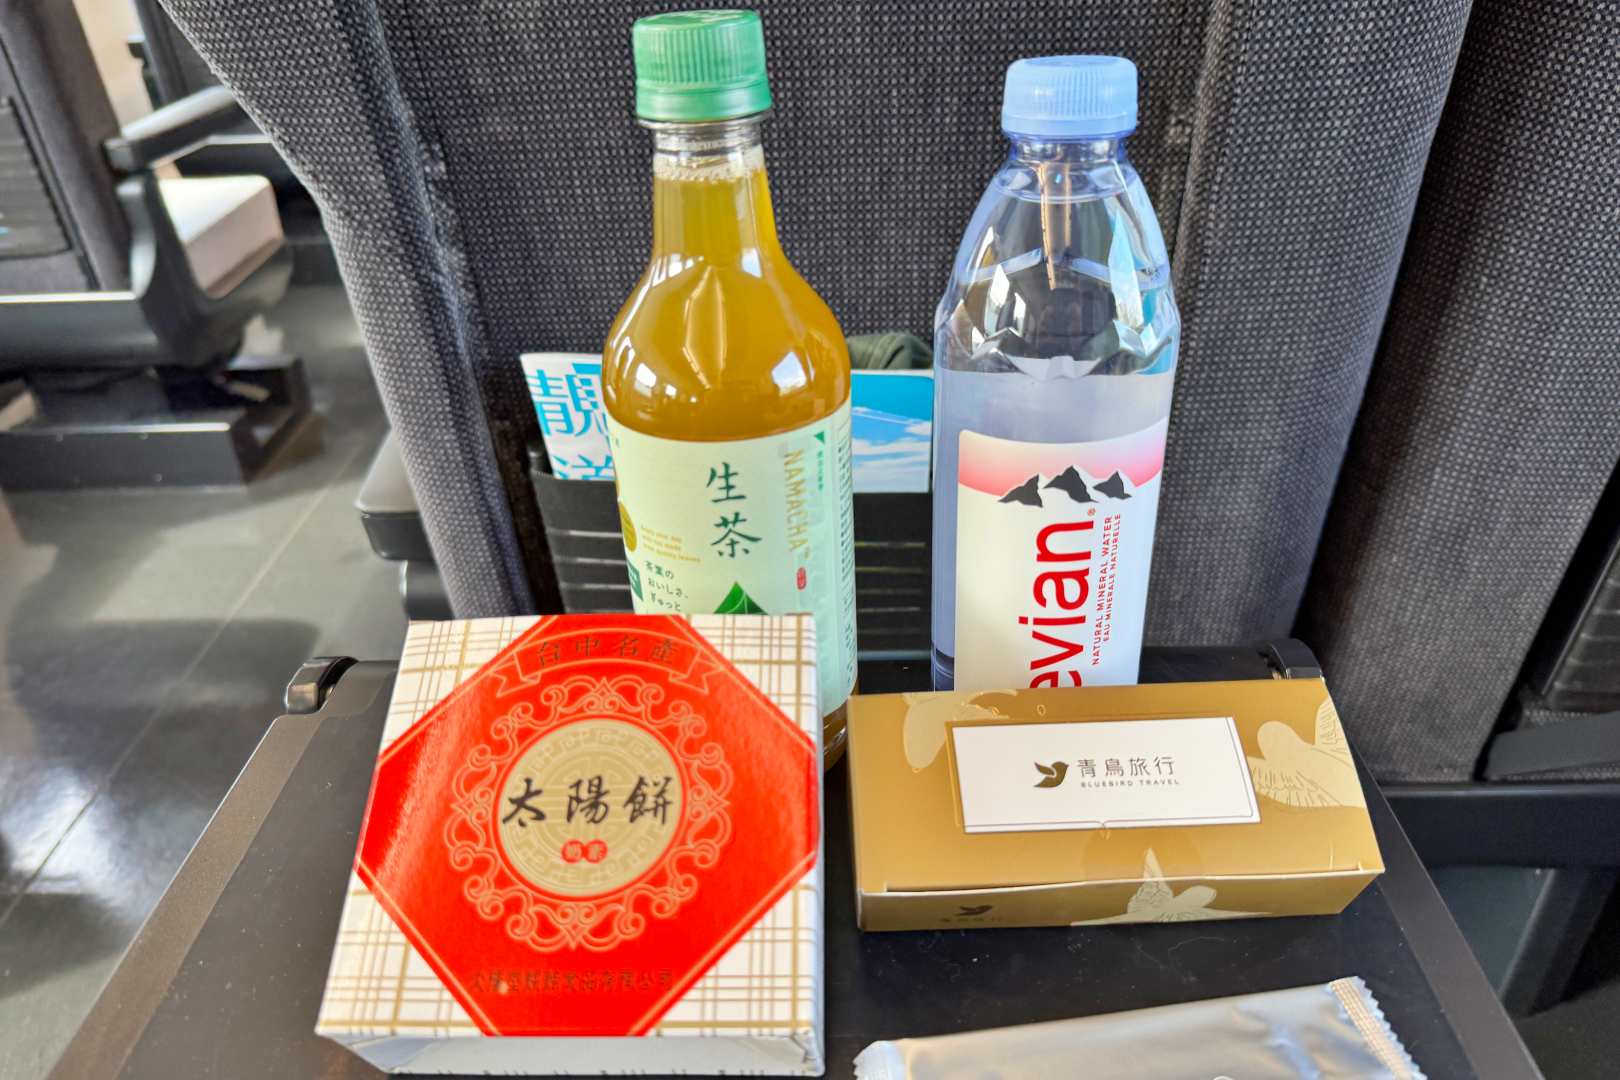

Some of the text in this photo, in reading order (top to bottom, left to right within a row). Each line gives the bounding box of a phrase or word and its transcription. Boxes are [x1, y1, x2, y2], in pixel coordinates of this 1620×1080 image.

[705, 461, 762, 559] 生茶
[784, 448, 809, 552] NAMACHA
[1110, 514, 1121, 570] NATURELLE
[1092, 516, 1113, 665] NATURAL MINERAL WATER
[1105, 573, 1116, 620] MINERALE
[1077, 756, 1175, 778] 青鳥旅行
[1081, 780, 1133, 788] BLUEBIRD
[502, 775, 673, 828] 太陽餅
